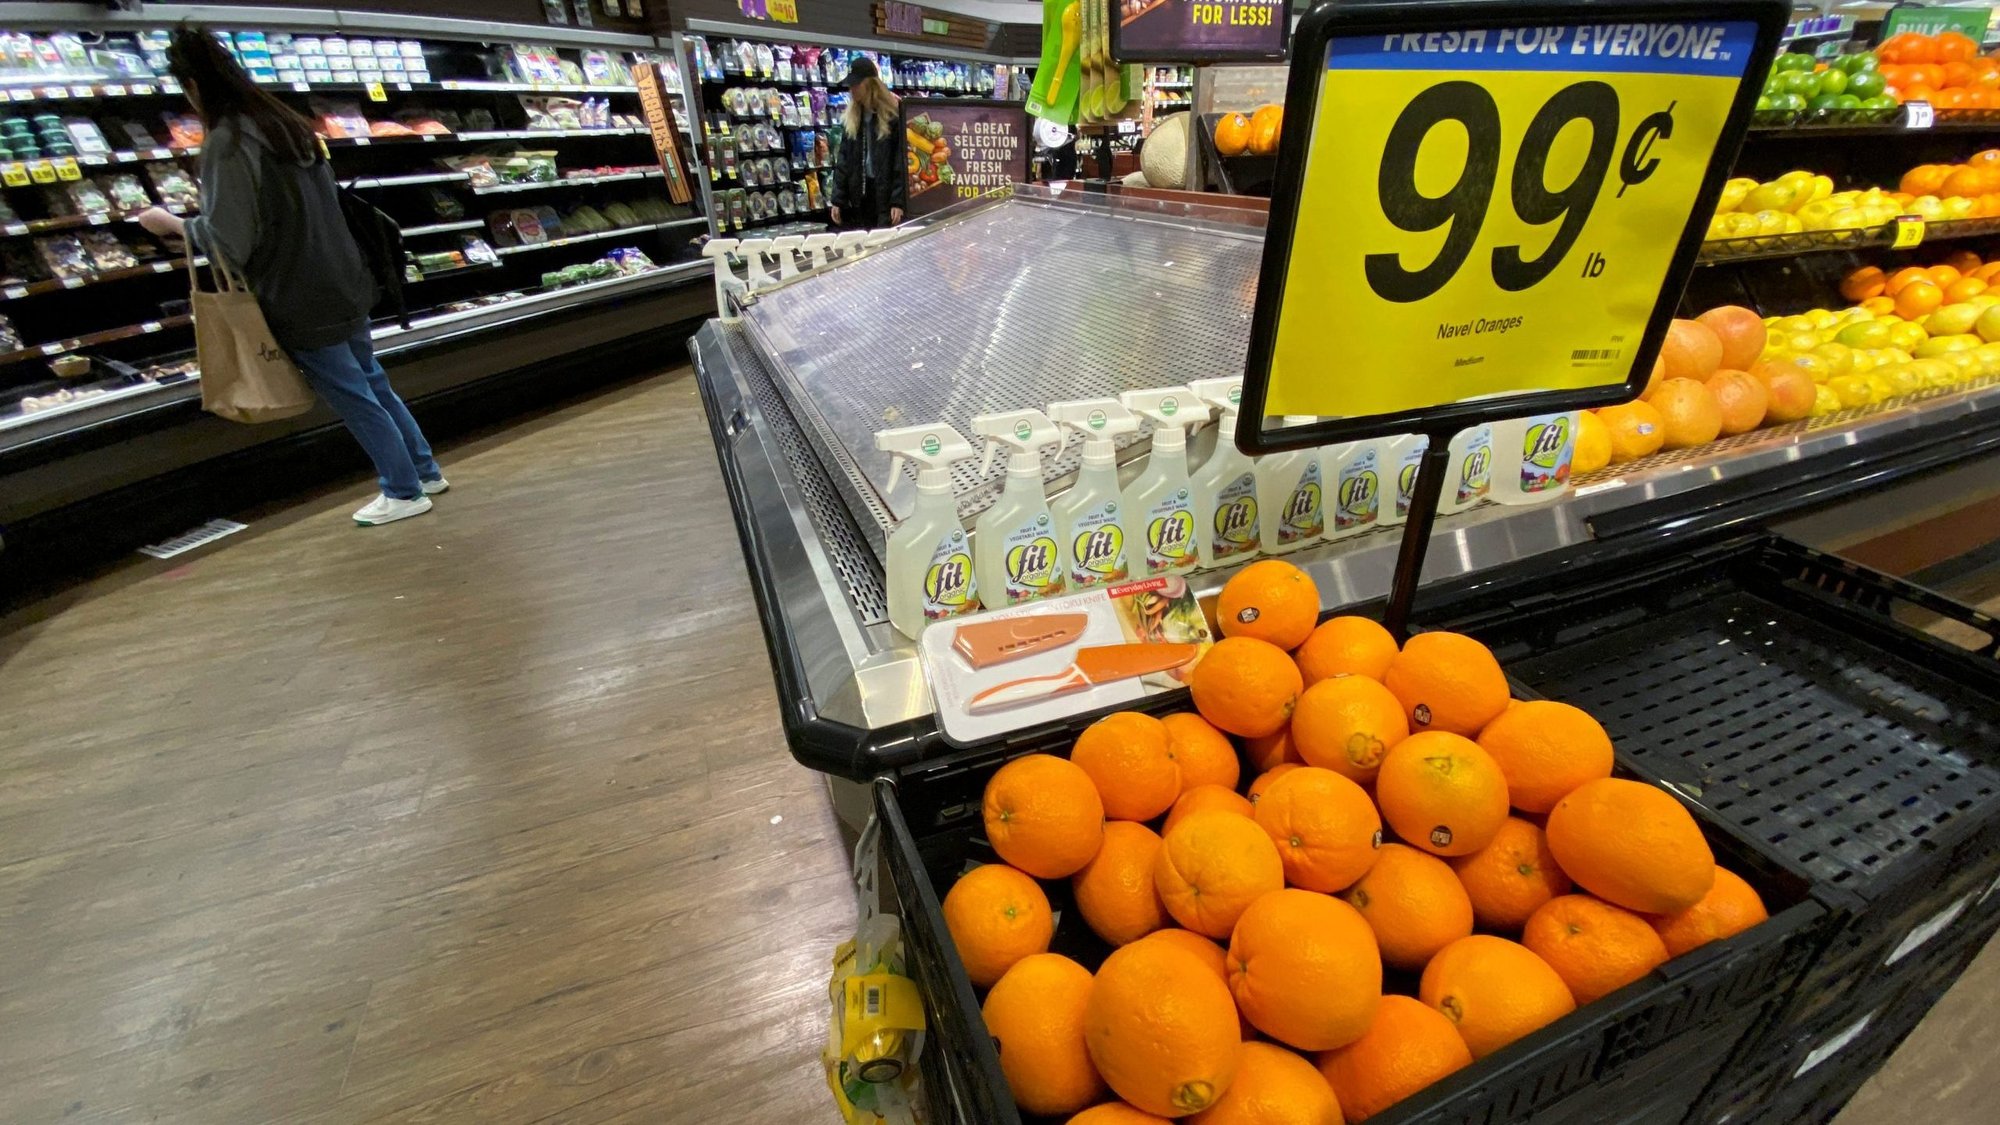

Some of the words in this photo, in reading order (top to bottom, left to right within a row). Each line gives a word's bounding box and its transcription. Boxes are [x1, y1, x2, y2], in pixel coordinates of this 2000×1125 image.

[1192, 4, 1223, 25] FOR
[1230, 5, 1273, 26] LESS!
[1383, 29, 1487, 53] FRESH
[1496, 26, 1564, 55] FOR
[638, 74, 673, 151] VEGGIES
[954, 135, 1018, 149] SELECTION
[961, 122, 969, 134] A
[974, 122, 1011, 135] GREAT
[961, 148, 976, 160] OF
[981, 148, 1012, 161] YOUR
[966, 161, 1002, 173] FRESH
[957, 186, 979, 198] FOR
[1581, 252, 1606, 279] lb
[1437, 320, 1475, 340] Navel
[1475, 314, 1523, 335] Oranges
[1523, 424, 1563, 461] fit
[1465, 452, 1486, 482] fit
[1341, 477, 1370, 511] fit
[1218, 504, 1250, 538] fit
[1284, 490, 1314, 526] fit
[1009, 532, 1036, 542] VEGETABLE
[1036, 529, 1050, 538] WASH
[1152, 517, 1185, 553] fit
[1078, 531, 1114, 568] fit
[1088, 556, 1114, 568] organic
[1010, 545, 1049, 584] fit
[1021, 569, 1050, 583] organic
[928, 562, 965, 604] fit
[939, 587, 966, 601] organic
